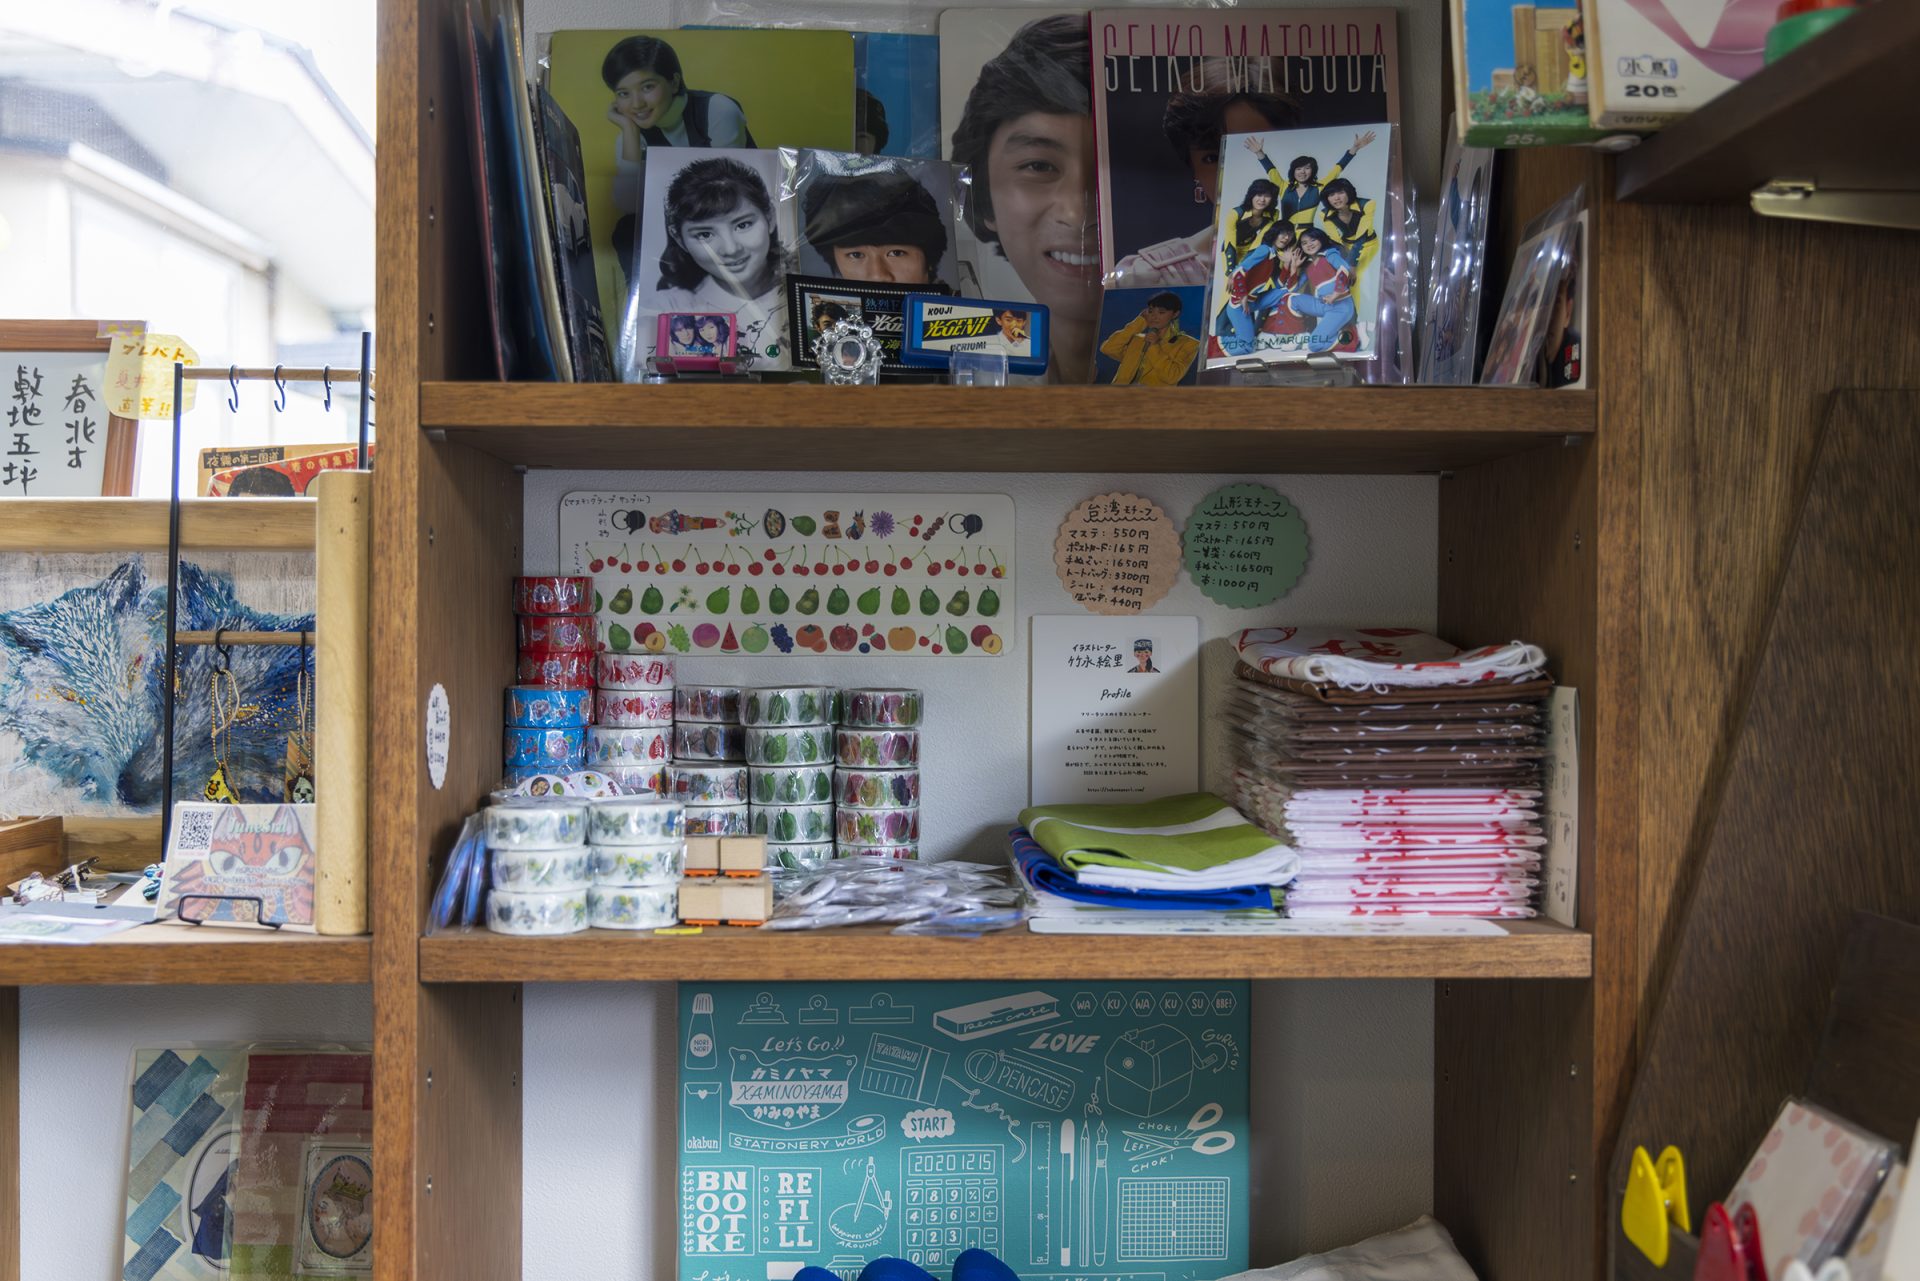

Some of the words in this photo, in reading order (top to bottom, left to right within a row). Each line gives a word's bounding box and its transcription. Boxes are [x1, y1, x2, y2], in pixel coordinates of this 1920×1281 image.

[1103, 24, 1204, 93] SEIKO
[1224, 23, 1387, 93] MATSUDA
[928, 306, 952, 316] KOUJI
[924, 316, 991, 338] 光GENJI
[1268, 334, 1334, 347] MARUBELL
[1233, 521, 1270, 531] 550円
[1113, 528, 1149, 540] 550円
[1071, 644, 1117, 652] イラストレーター
[1067, 653, 1124, 669] 竹永絵里
[1100, 688, 1132, 701] Profile
[1076, 1000, 1091, 1010] WA
[1107, 999, 1120, 1009] KU
[1135, 998, 1150, 1009] WA
[1165, 999, 1178, 1009] KU
[1191, 998, 1204, 1009] SU
[761, 1036, 802, 1052] Let's
[807, 1035, 846, 1052] Go!!
[1029, 1032, 1101, 1053] LOVE
[750, 1068, 833, 1080] カミノヤマ
[997, 1065, 1070, 1108] PENCASE
[753, 1105, 821, 1119] かみのやま
[910, 1116, 949, 1132] START
[1138, 1122, 1178, 1132] CHOKI
[687, 1135, 719, 1150] okabun
[733, 1136, 830, 1150] STATIONERY
[835, 1128, 884, 1149] WORLD
[1123, 1138, 1151, 1152] LEFT
[1131, 1154, 1174, 1173] CHOKI
[910, 1191, 919, 1203] 7
[929, 1190, 938, 1202] 8
[950, 1190, 958, 1202] 9
[910, 1211, 919, 1222] 4
[929, 1210, 938, 1222] 5
[950, 1209, 958, 1221] 6
[911, 1232, 918, 1243] 1
[929, 1231, 938, 1243] 2
[949, 1230, 957, 1243] 3
